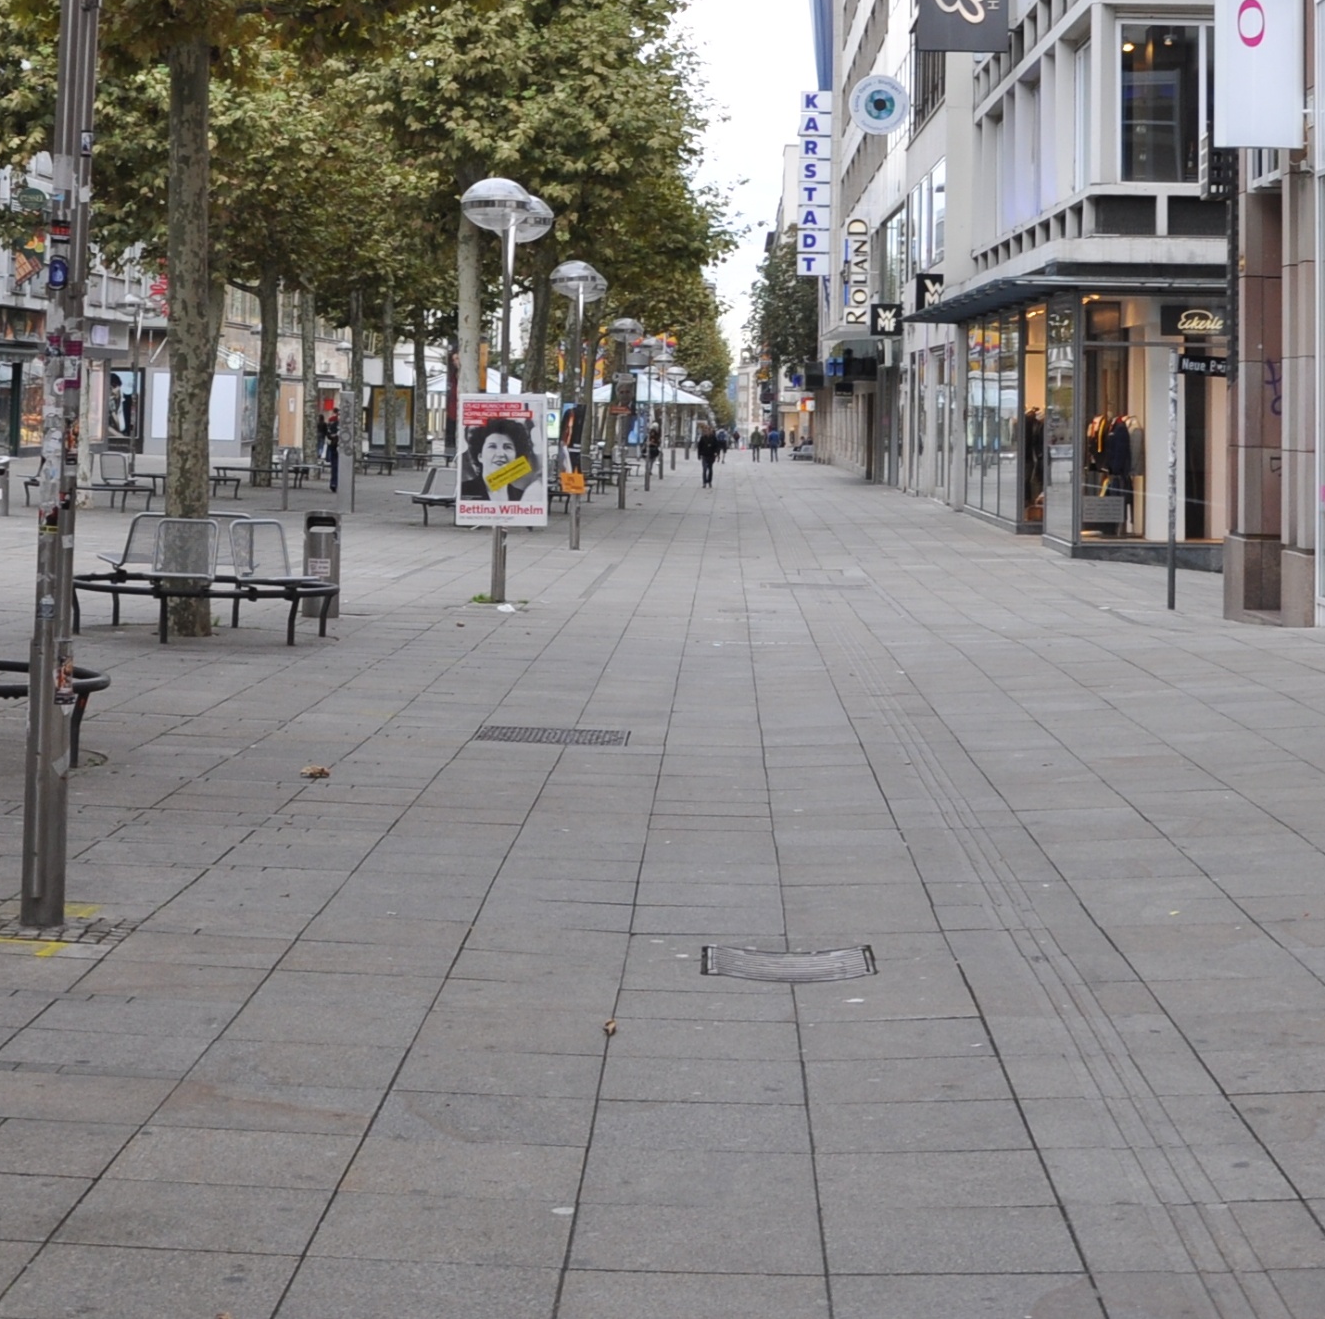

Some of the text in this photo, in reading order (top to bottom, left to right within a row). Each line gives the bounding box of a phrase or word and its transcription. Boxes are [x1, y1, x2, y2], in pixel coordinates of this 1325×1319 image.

[801, 92, 820, 274] KARSTADT
[845, 217, 869, 326] ROLAND
[1177, 309, 1224, 330] Eckerle
[1181, 358, 1206, 372] Neue
[459, 504, 544, 515] Bettina Wilhelm
